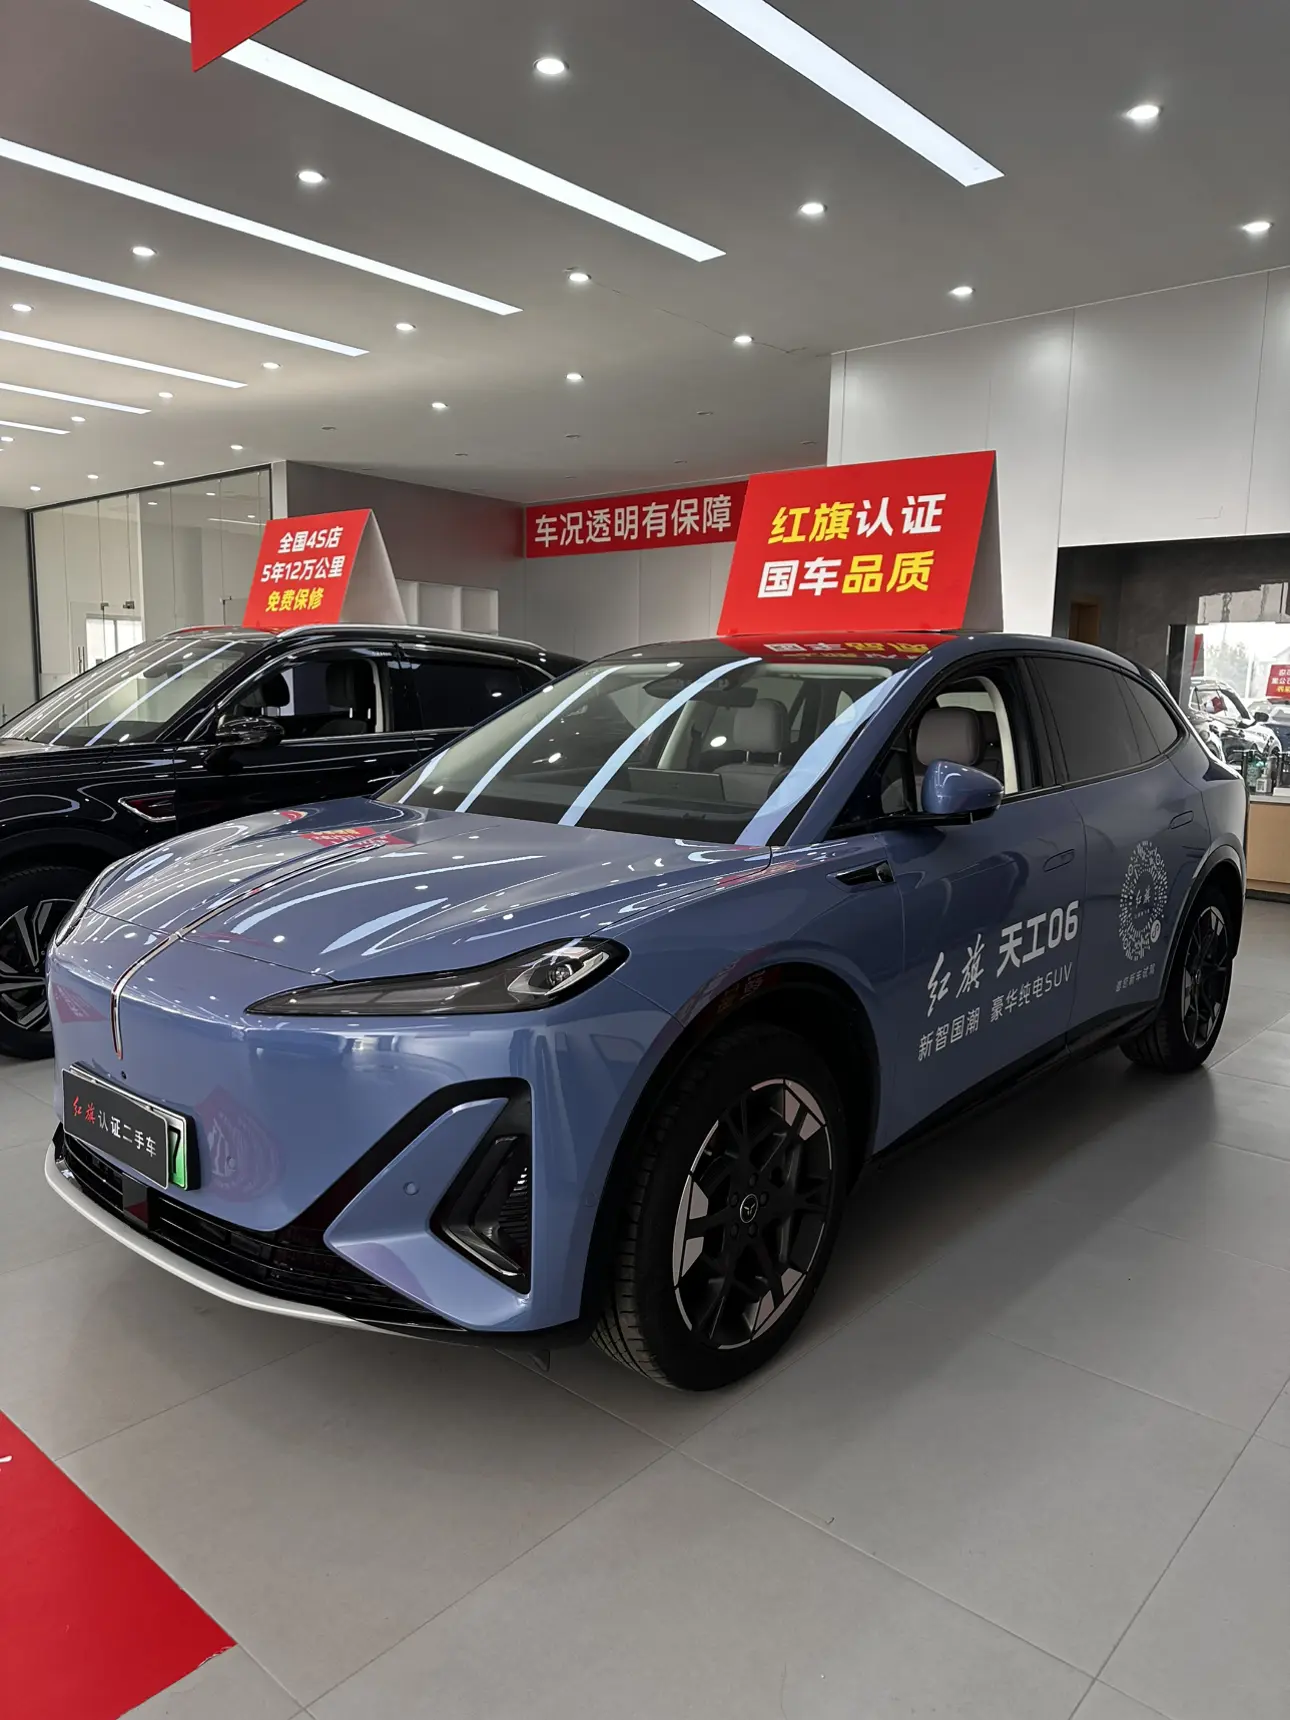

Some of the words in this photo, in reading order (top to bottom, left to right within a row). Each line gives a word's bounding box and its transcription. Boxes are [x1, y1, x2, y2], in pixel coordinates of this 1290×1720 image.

[278, 526, 344, 554] 全国4S店
[534, 493, 732, 548] 车况透明有保障
[768, 493, 947, 544] 红旗认证
[261, 555, 345, 584] 5年12万公里
[757, 550, 935, 599] 国车品质
[266, 587, 325, 613] 免费保修
[926, 933, 985, 1017] 红旗
[997, 900, 1080, 978] 天工06
[917, 1007, 981, 1062] 新智国潮
[990, 961, 1073, 1023] 豪华纯电SUV
[72, 1096, 157, 1158] 红旗认证二手车
